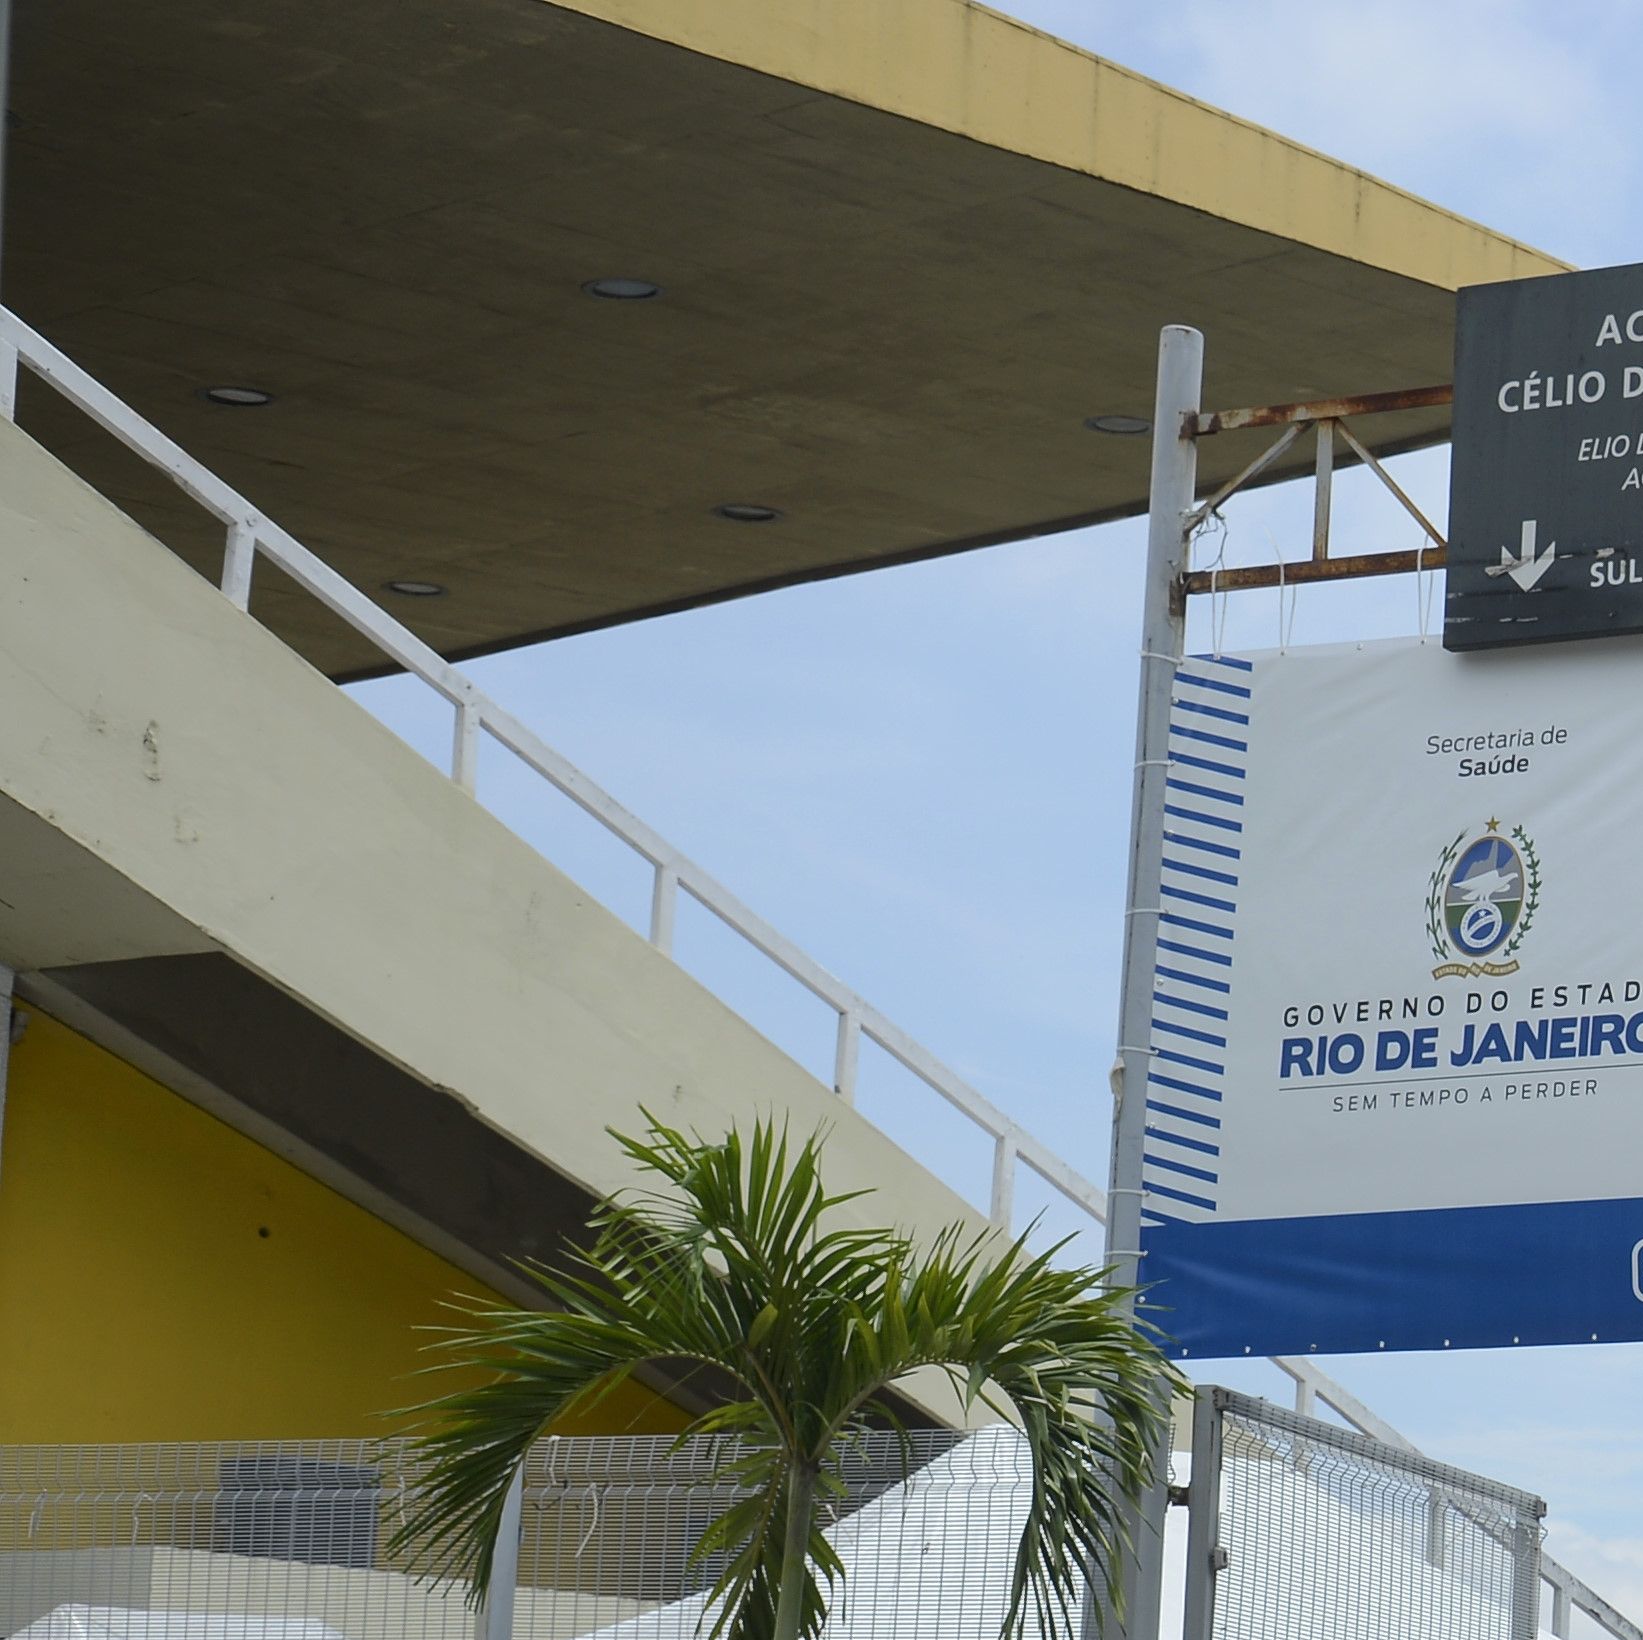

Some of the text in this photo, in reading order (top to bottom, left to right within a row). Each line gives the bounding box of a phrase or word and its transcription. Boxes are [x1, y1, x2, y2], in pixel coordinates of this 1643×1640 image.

[1499, 371, 1605, 412] CÉLIO
[1578, 435, 1630, 461] ELIO
[1591, 560, 1642, 587] SUL
[1427, 725, 1567, 754] Secretaria de
[1459, 755, 1528, 777] Saúde
[1284, 996, 1444, 1027] GOVERNO
[1467, 991, 1508, 1013] DO
[1280, 1034, 1364, 1078] RIO
[1376, 1028, 1438, 1071] DE
[1333, 1080, 1597, 1112] SEM TEMPO A PERDER
